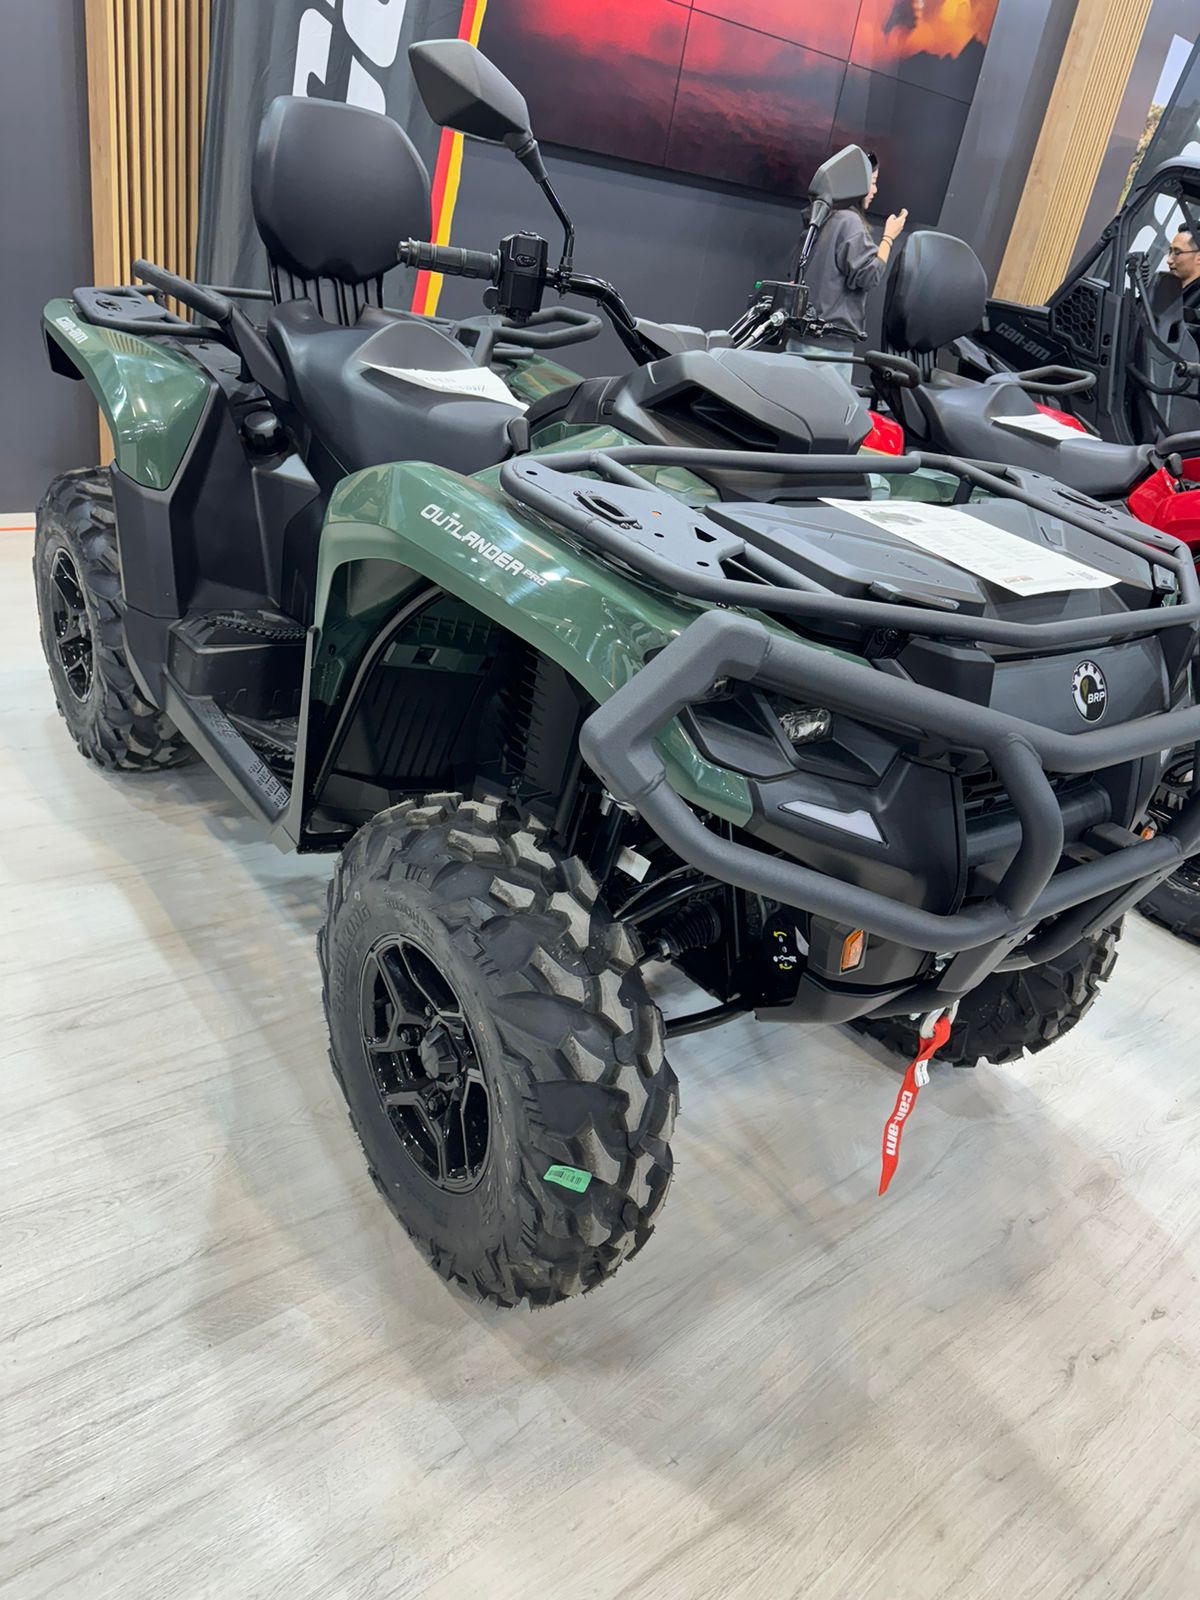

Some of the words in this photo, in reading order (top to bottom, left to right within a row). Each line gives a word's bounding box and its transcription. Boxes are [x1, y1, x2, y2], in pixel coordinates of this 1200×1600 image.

[995, 322, 1051, 361] can-am
[420, 503, 524, 576] OUTLANDER
[523, 568, 548, 587] PRO
[1087, 690, 1105, 705] BRP
[886, 1090, 913, 1156] can-am
